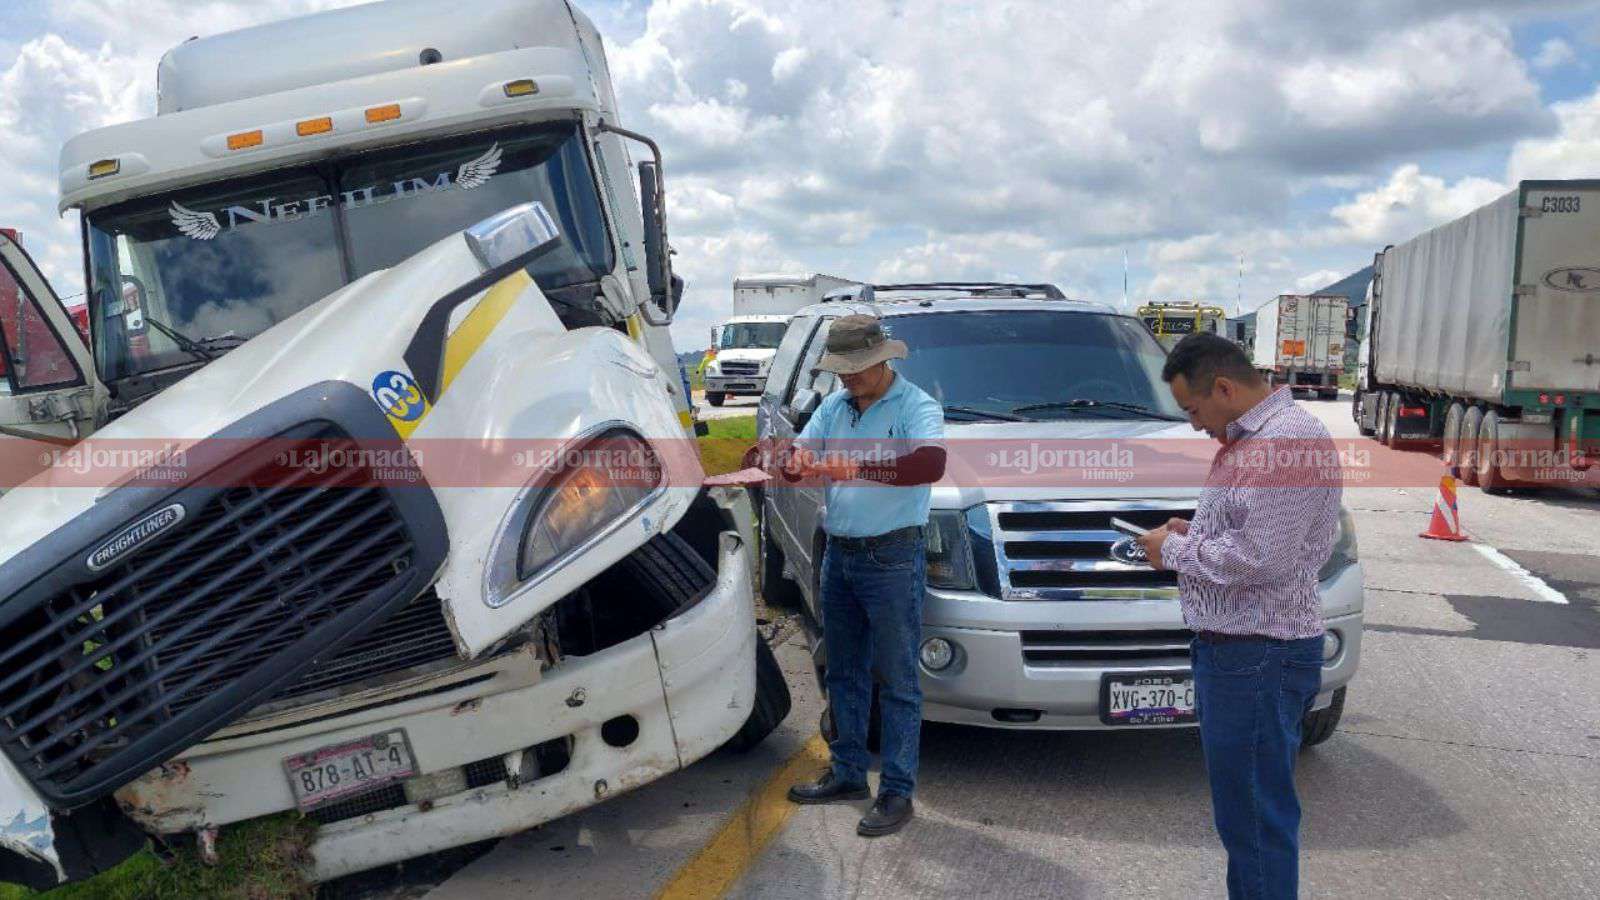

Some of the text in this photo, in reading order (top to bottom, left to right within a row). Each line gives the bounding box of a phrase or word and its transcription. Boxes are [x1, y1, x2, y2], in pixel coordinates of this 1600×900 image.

[1542, 197, 1580, 213] C3033
[377, 374, 420, 417] 03
[95, 510, 174, 563] FREIGHTLINER
[1112, 688, 1194, 710] XVG-370-C
[301, 745, 402, 792] 878-AT-4
